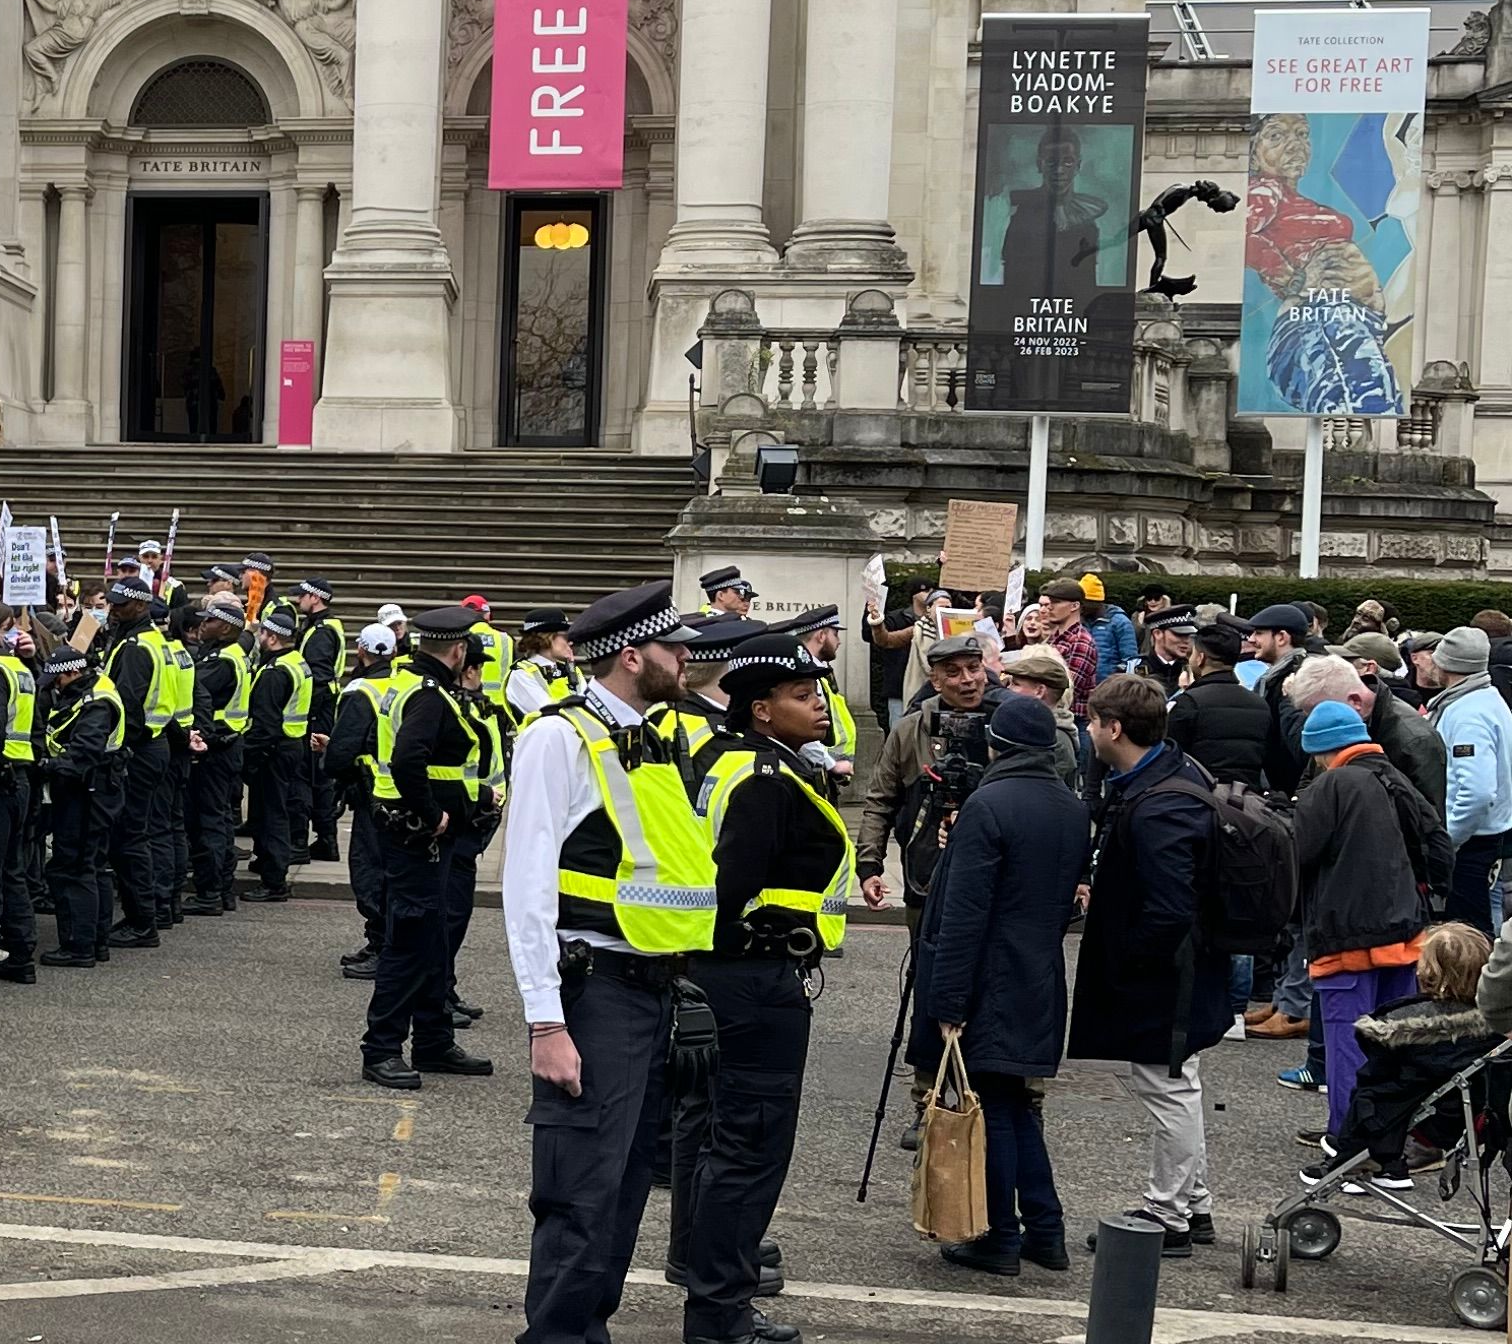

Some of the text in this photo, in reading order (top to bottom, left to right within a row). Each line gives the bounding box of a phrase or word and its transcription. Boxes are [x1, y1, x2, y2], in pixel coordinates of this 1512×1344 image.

[1298, 36, 1384, 46] TATE COLLECTION
[1012, 50, 1116, 70] LYNETTE
[1266, 57, 1414, 74] SEE GREAT ART
[529, 6, 587, 156] FREE
[1011, 72, 1115, 92] YIADOM-
[1294, 77, 1383, 93] FOR FREE
[1010, 94, 1113, 114] BOAKYE
[139, 160, 262, 173] TATE BRITAIN
[1306, 287, 1352, 303] TATE
[1030, 298, 1074, 314] TATE
[1289, 306, 1366, 323] BRITAIN
[1013, 316, 1088, 334] BRITAIN
[1013, 337, 1025, 346] 24
[1028, 337, 1050, 346] NOV
[1053, 337, 1078, 347] 2022
[1020, 346, 1079, 356] 26 FEB 2023
[11, 542, 31, 552] Don't
